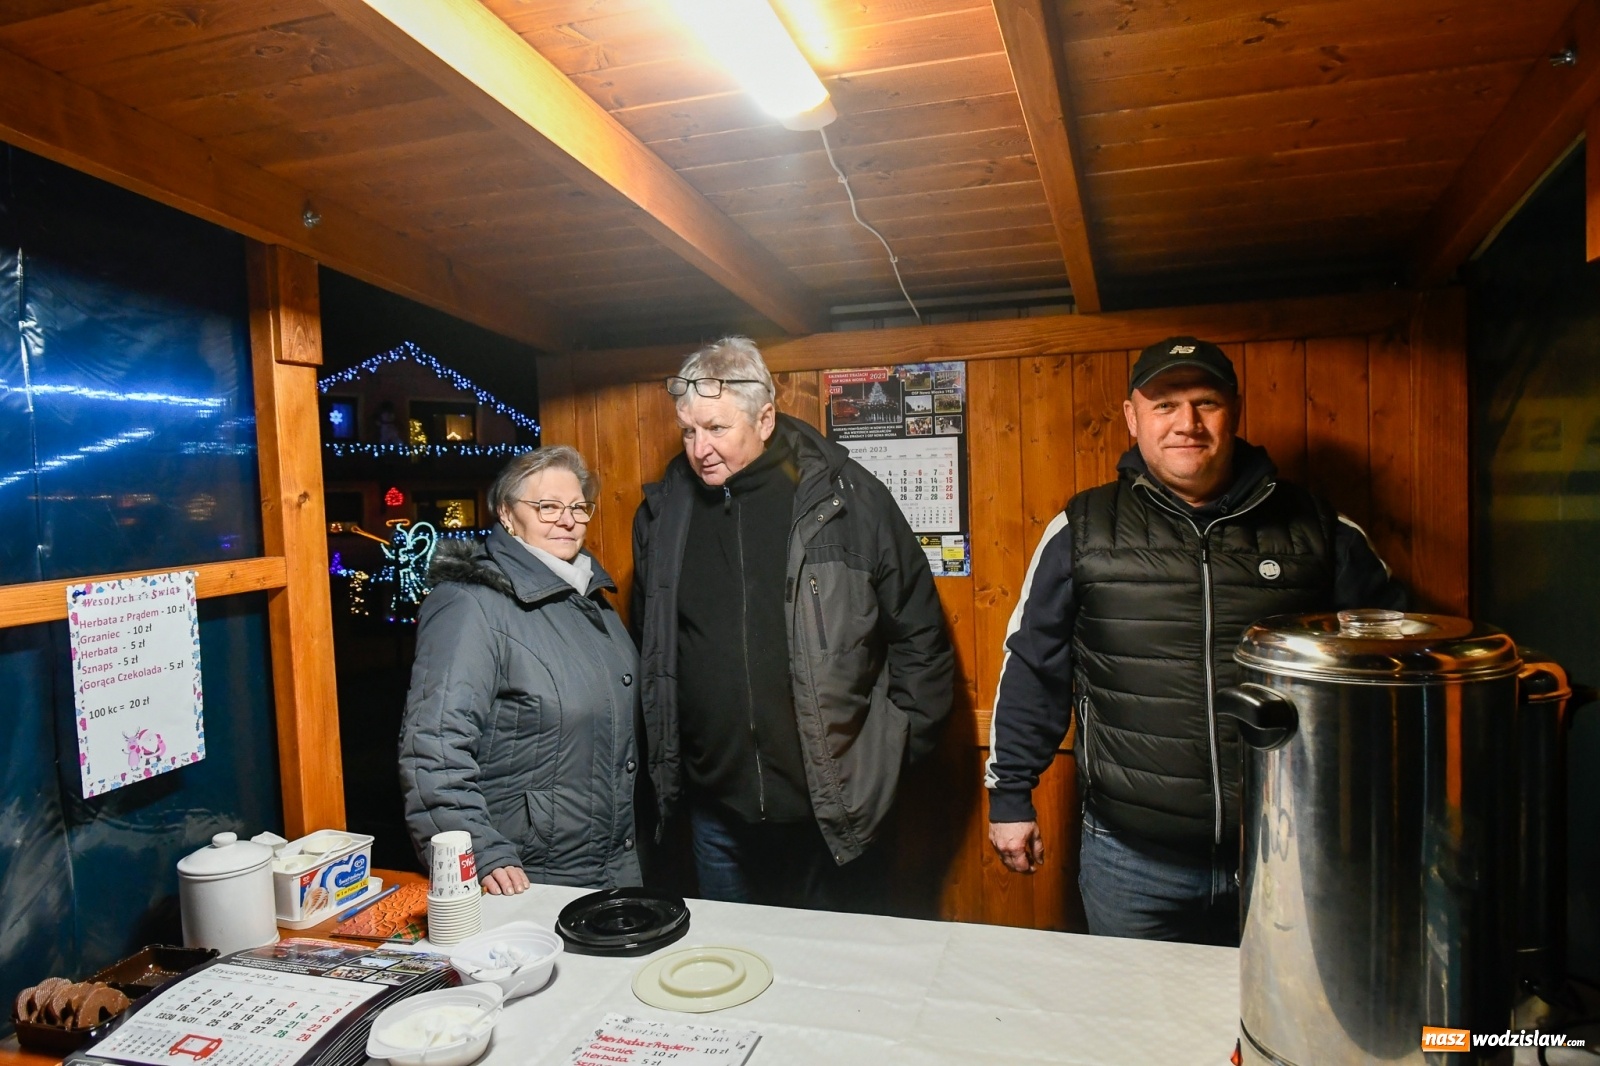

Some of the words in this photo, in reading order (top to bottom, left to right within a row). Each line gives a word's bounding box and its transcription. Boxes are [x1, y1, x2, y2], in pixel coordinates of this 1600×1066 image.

[81, 593, 134, 608] Wesołych
[79, 615, 118, 629] Herbata
[126, 609, 159, 622] Prądem
[167, 605, 177, 615] 10
[179, 603, 185, 613] zł
[80, 630, 120, 644] Grzaniec
[133, 625, 143, 635] 10
[145, 623, 152, 632] zł
[81, 646, 118, 659] Herbata
[131, 641, 136, 649] 5
[138, 638, 145, 648] zł
[82, 661, 113, 675] Sznaps
[123, 657, 129, 666] 5
[131, 655, 138, 664] zł
[83, 676, 115, 690] Gorąca
[117, 665, 162, 682] Czekolada
[169, 662, 175, 671] 5
[177, 660, 184, 669] zł
[89, 708, 106, 720] 100
[108, 705, 118, 715] kc
[129, 698, 141, 709] 20
[142, 696, 150, 706] zł
[209, 967, 249, 977] Styczeń
[250, 973, 279, 981] 2023
[175, 1003, 190, 1012] 16
[196, 1006, 211, 1014] 17
[218, 1010, 232, 1018] 18
[240, 1013, 254, 1021] 19
[261, 1017, 277, 1025] 20
[285, 1020, 300, 1029] 21
[306, 1023, 322, 1032] 22
[231, 1002, 244, 1010] 11
[251, 1005, 265, 1013] 12
[273, 1008, 287, 1016] 13
[296, 1012, 309, 1020] 14
[319, 1015, 332, 1023] 15
[206, 1019, 221, 1027] 25
[227, 1022, 243, 1031] 26
[250, 1026, 266, 1034] 27
[273, 1029, 289, 1038] 28
[296, 1033, 312, 1042] 29
[597, 1034, 645, 1047] Herbata
[582, 1051, 629, 1063] Herbata
[589, 1043, 637, 1055] Grzaniec
